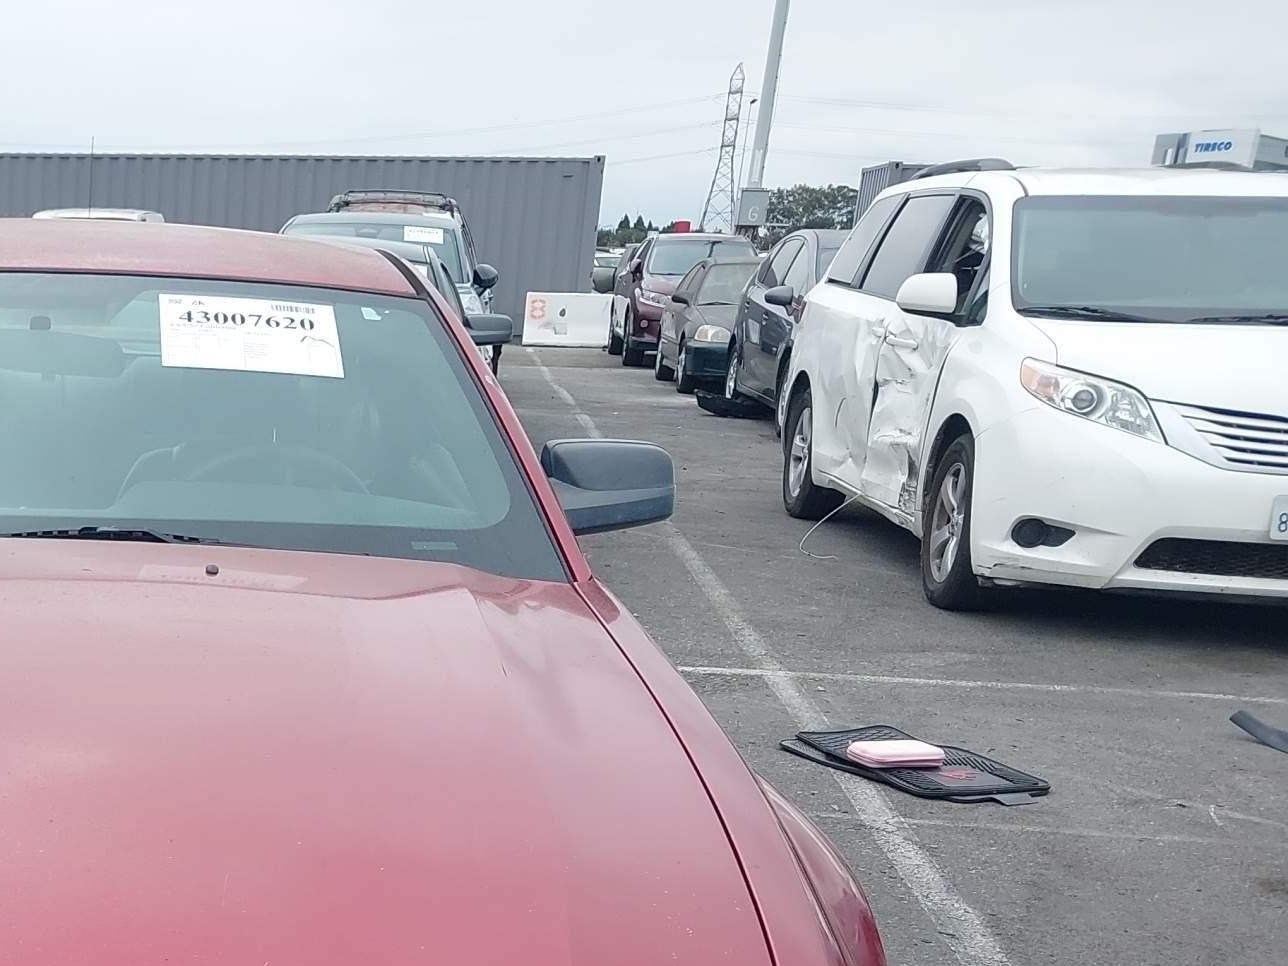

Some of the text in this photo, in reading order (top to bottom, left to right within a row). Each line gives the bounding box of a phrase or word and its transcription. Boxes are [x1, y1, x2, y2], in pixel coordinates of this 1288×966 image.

[1194, 141, 1233, 153] TIRECO
[748, 206, 760, 222] G
[178, 310, 316, 331] 43007620
